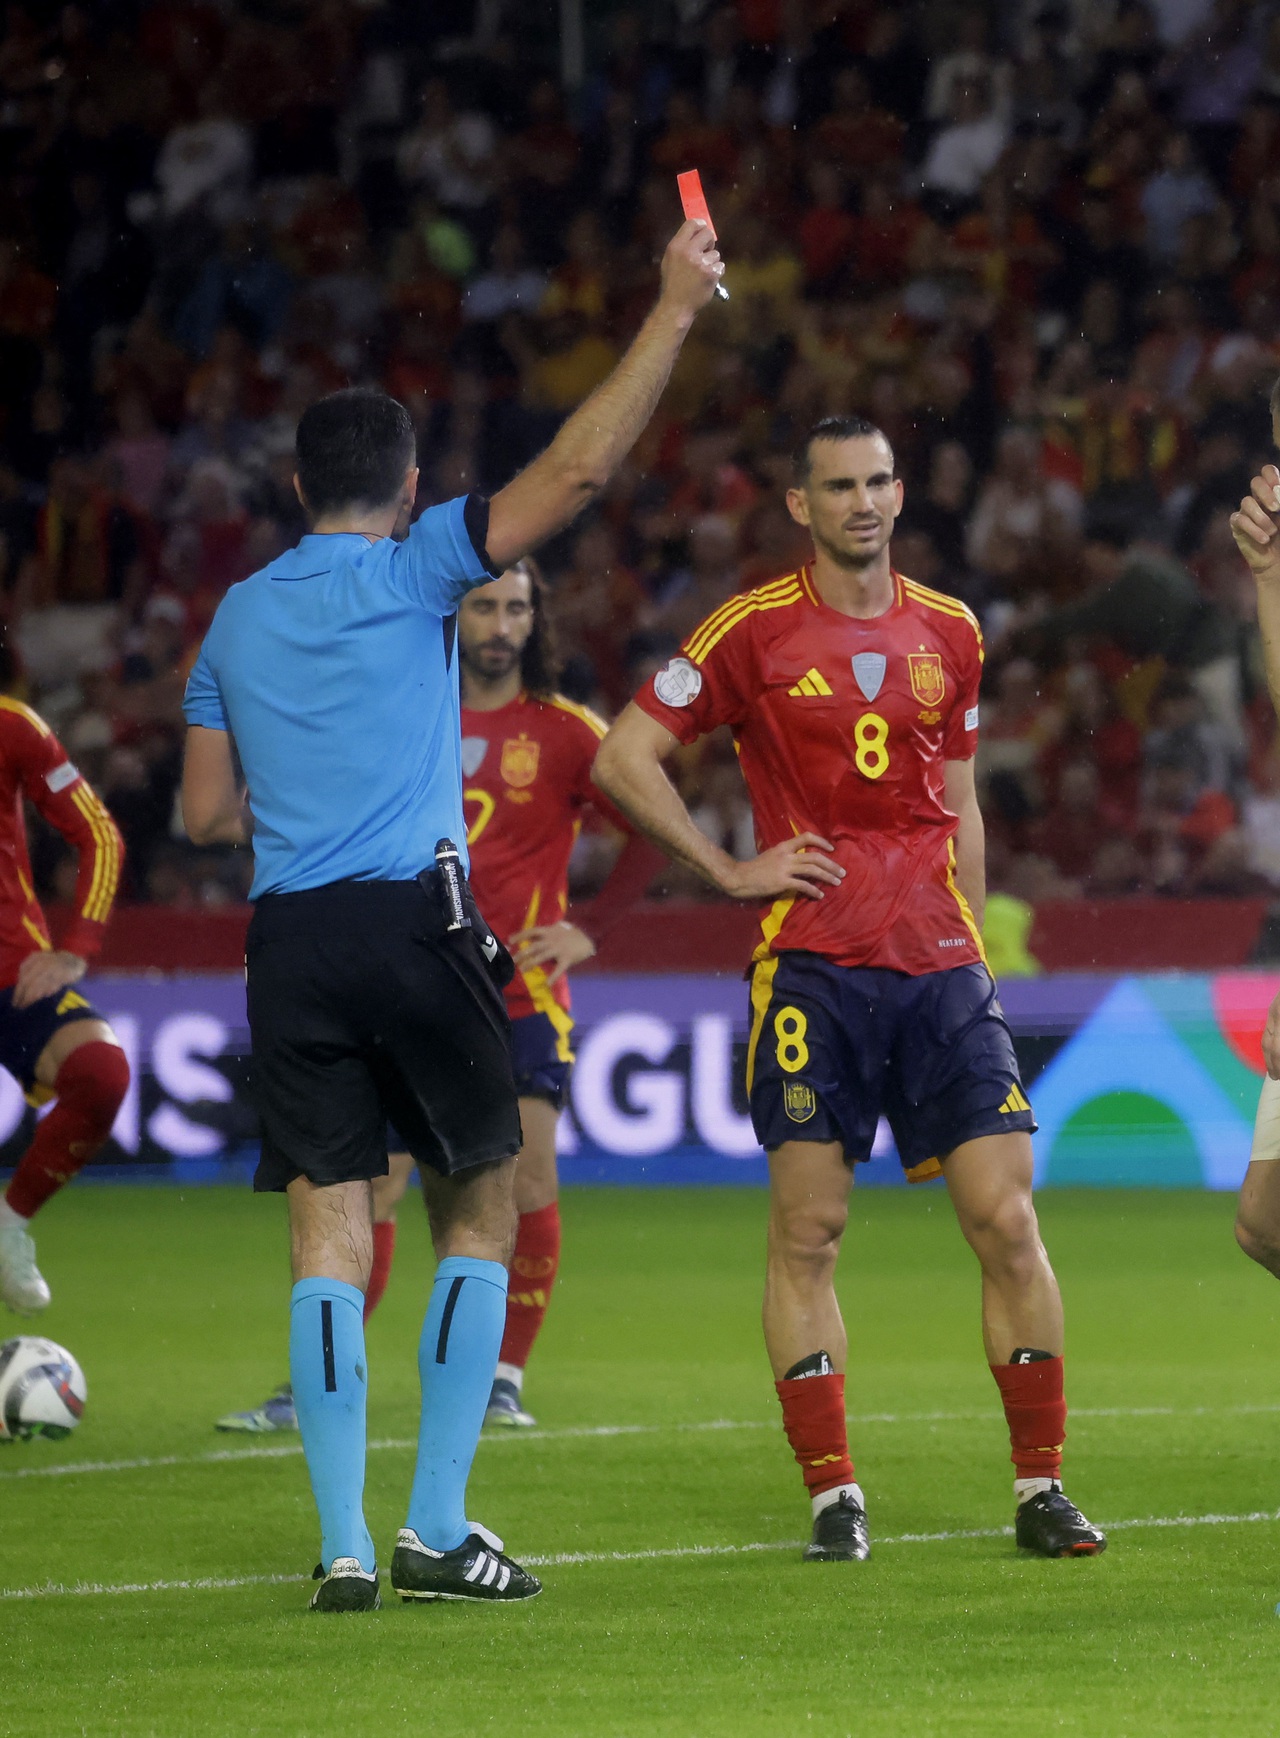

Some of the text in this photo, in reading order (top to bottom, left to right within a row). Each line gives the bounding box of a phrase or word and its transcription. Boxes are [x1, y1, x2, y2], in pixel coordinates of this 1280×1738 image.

[854, 712, 890, 779] 8
[774, 1006, 809, 1072] 8
[821, 1355, 829, 1375] 6
